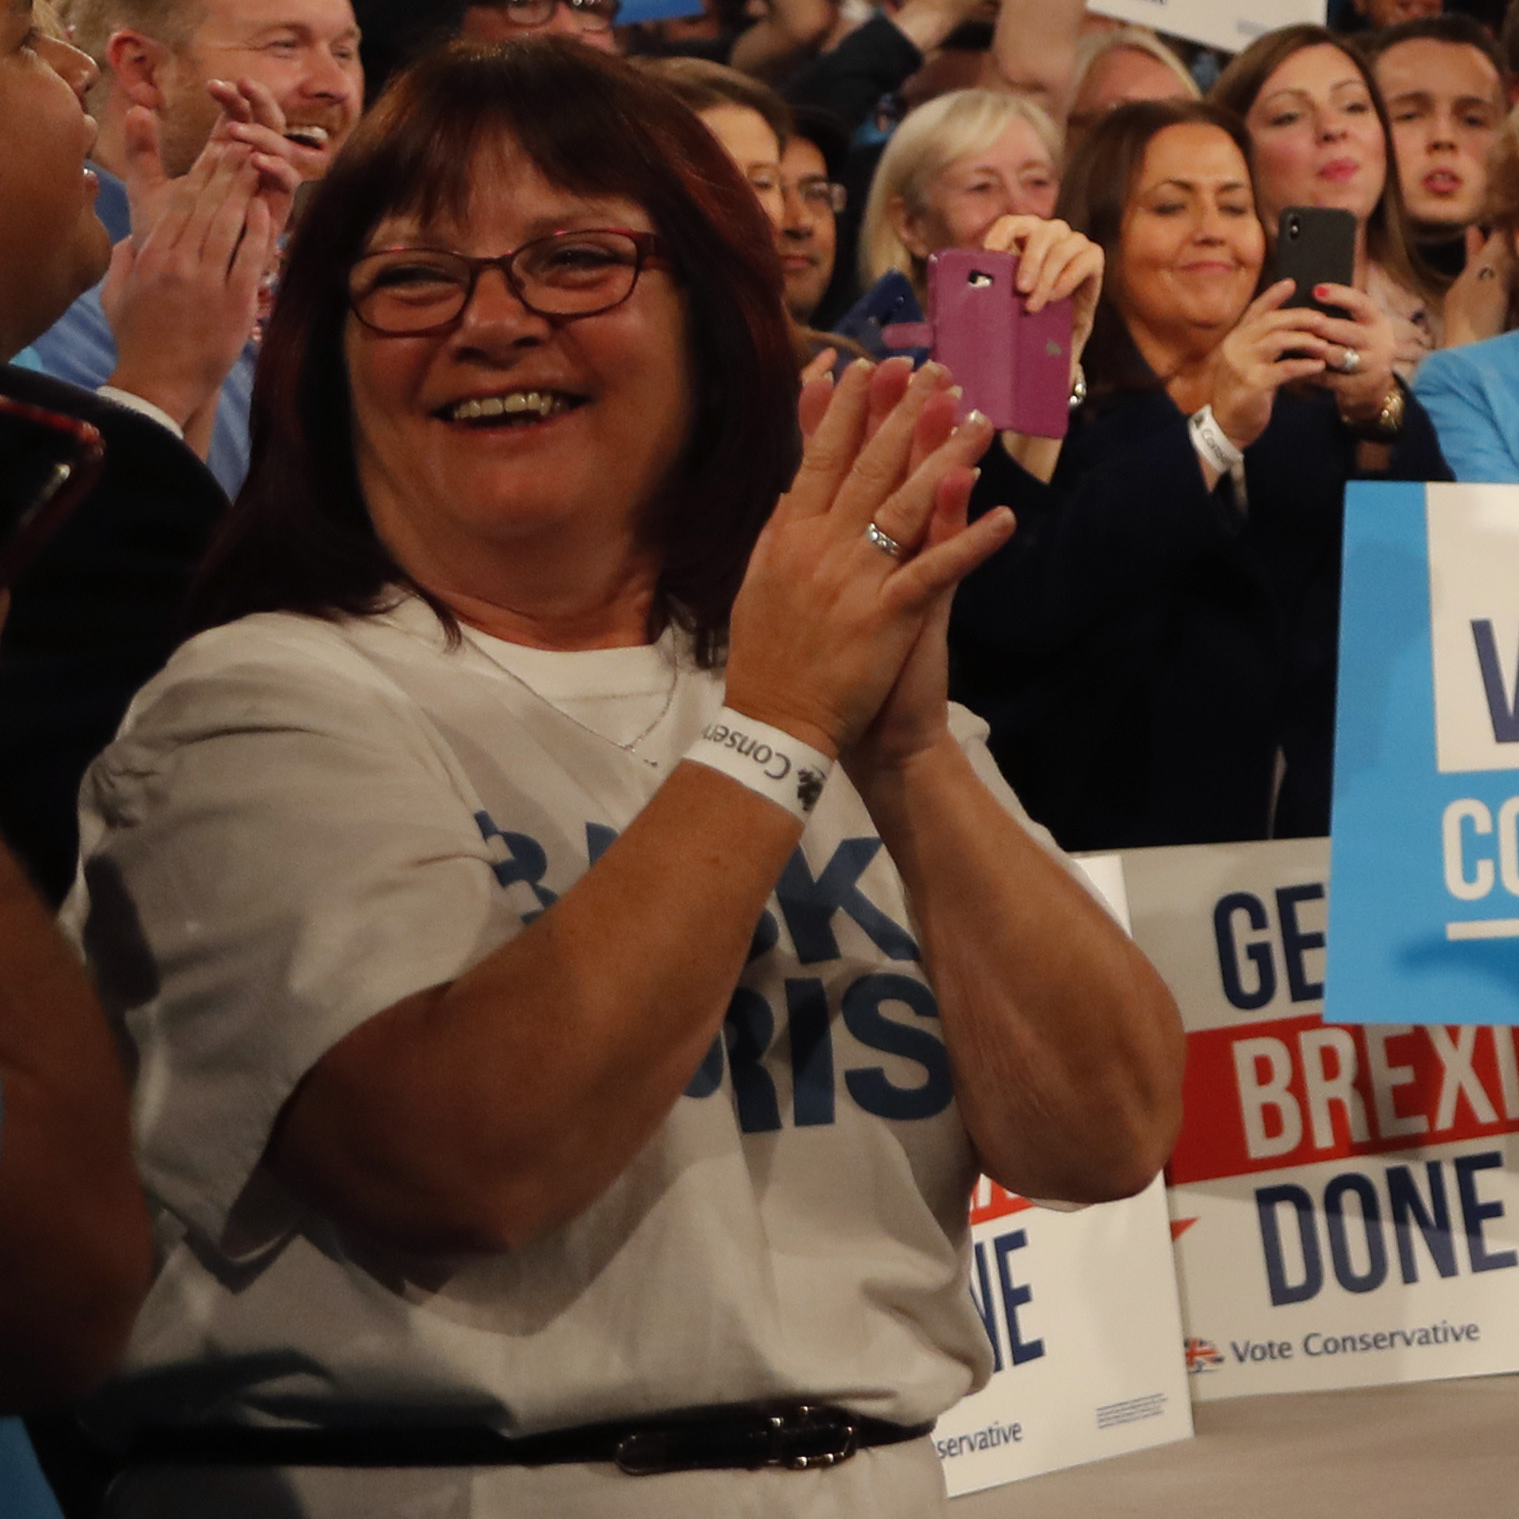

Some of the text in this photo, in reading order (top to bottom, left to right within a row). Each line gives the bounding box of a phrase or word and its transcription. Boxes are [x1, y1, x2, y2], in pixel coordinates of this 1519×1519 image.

[1212, 882, 1326, 1011] GE
[1254, 1150, 1519, 1307] DONE
[1230, 1319, 1482, 1365] Vote Conservative
